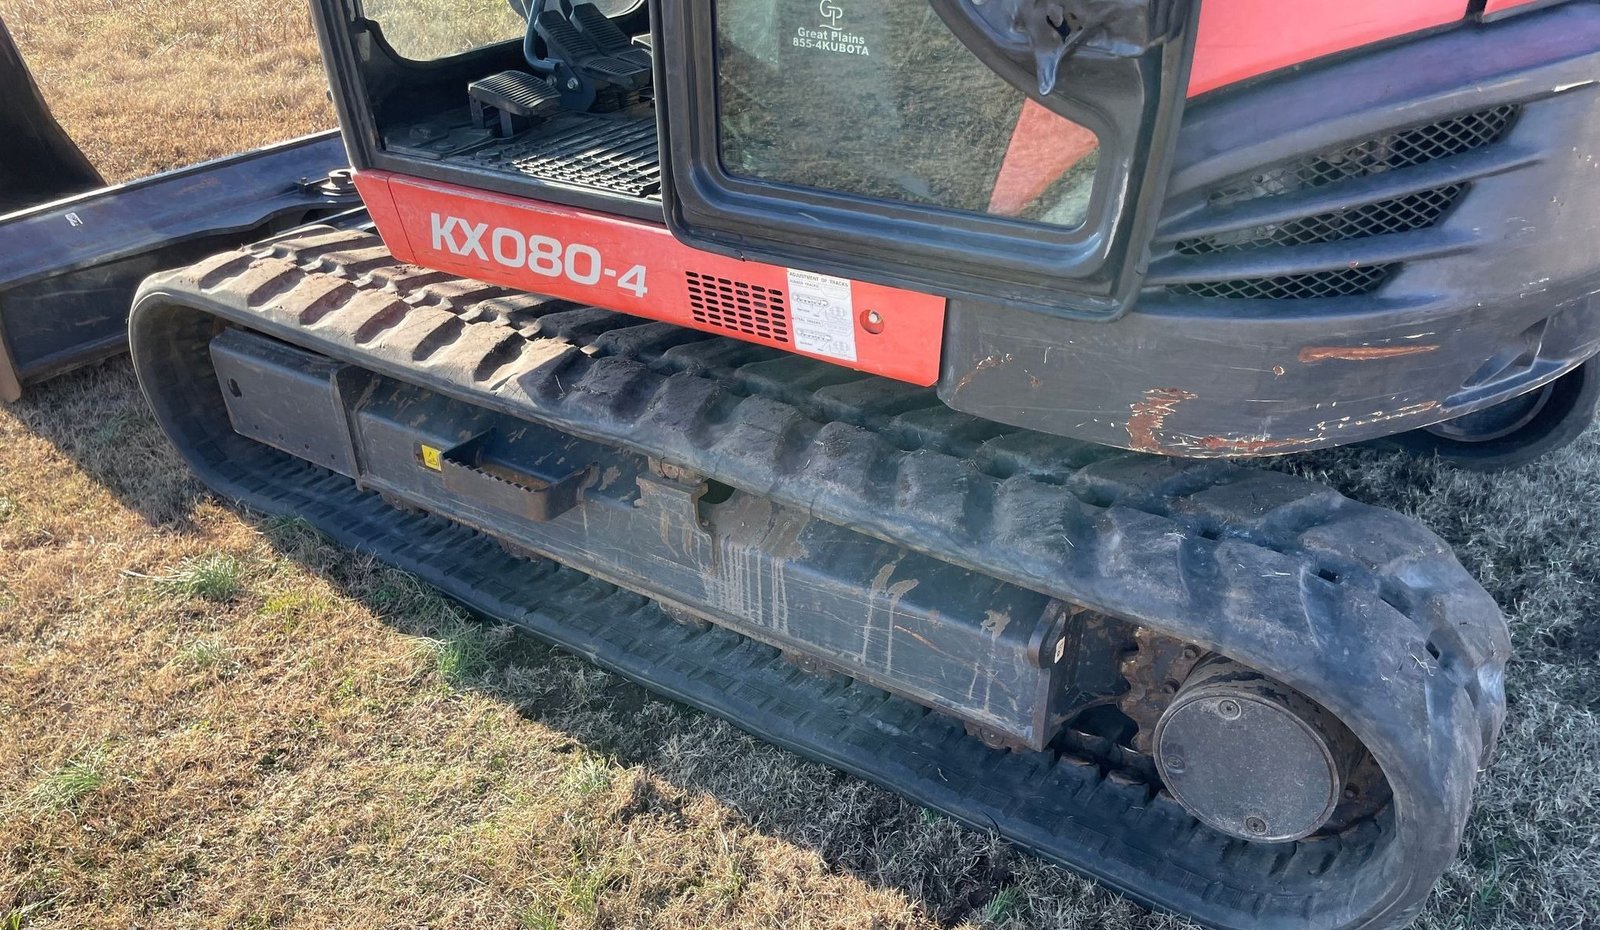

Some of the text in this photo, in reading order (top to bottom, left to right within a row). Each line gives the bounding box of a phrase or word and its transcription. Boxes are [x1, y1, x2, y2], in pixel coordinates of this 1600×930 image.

[798, 27, 865, 44] Great Plains
[793, 37, 869, 56] 855-4KUBOTA
[431, 212, 648, 298] KX080-4
[789, 272, 819, 281] ADJUSTMENT
[829, 279, 849, 287] TRACKS
